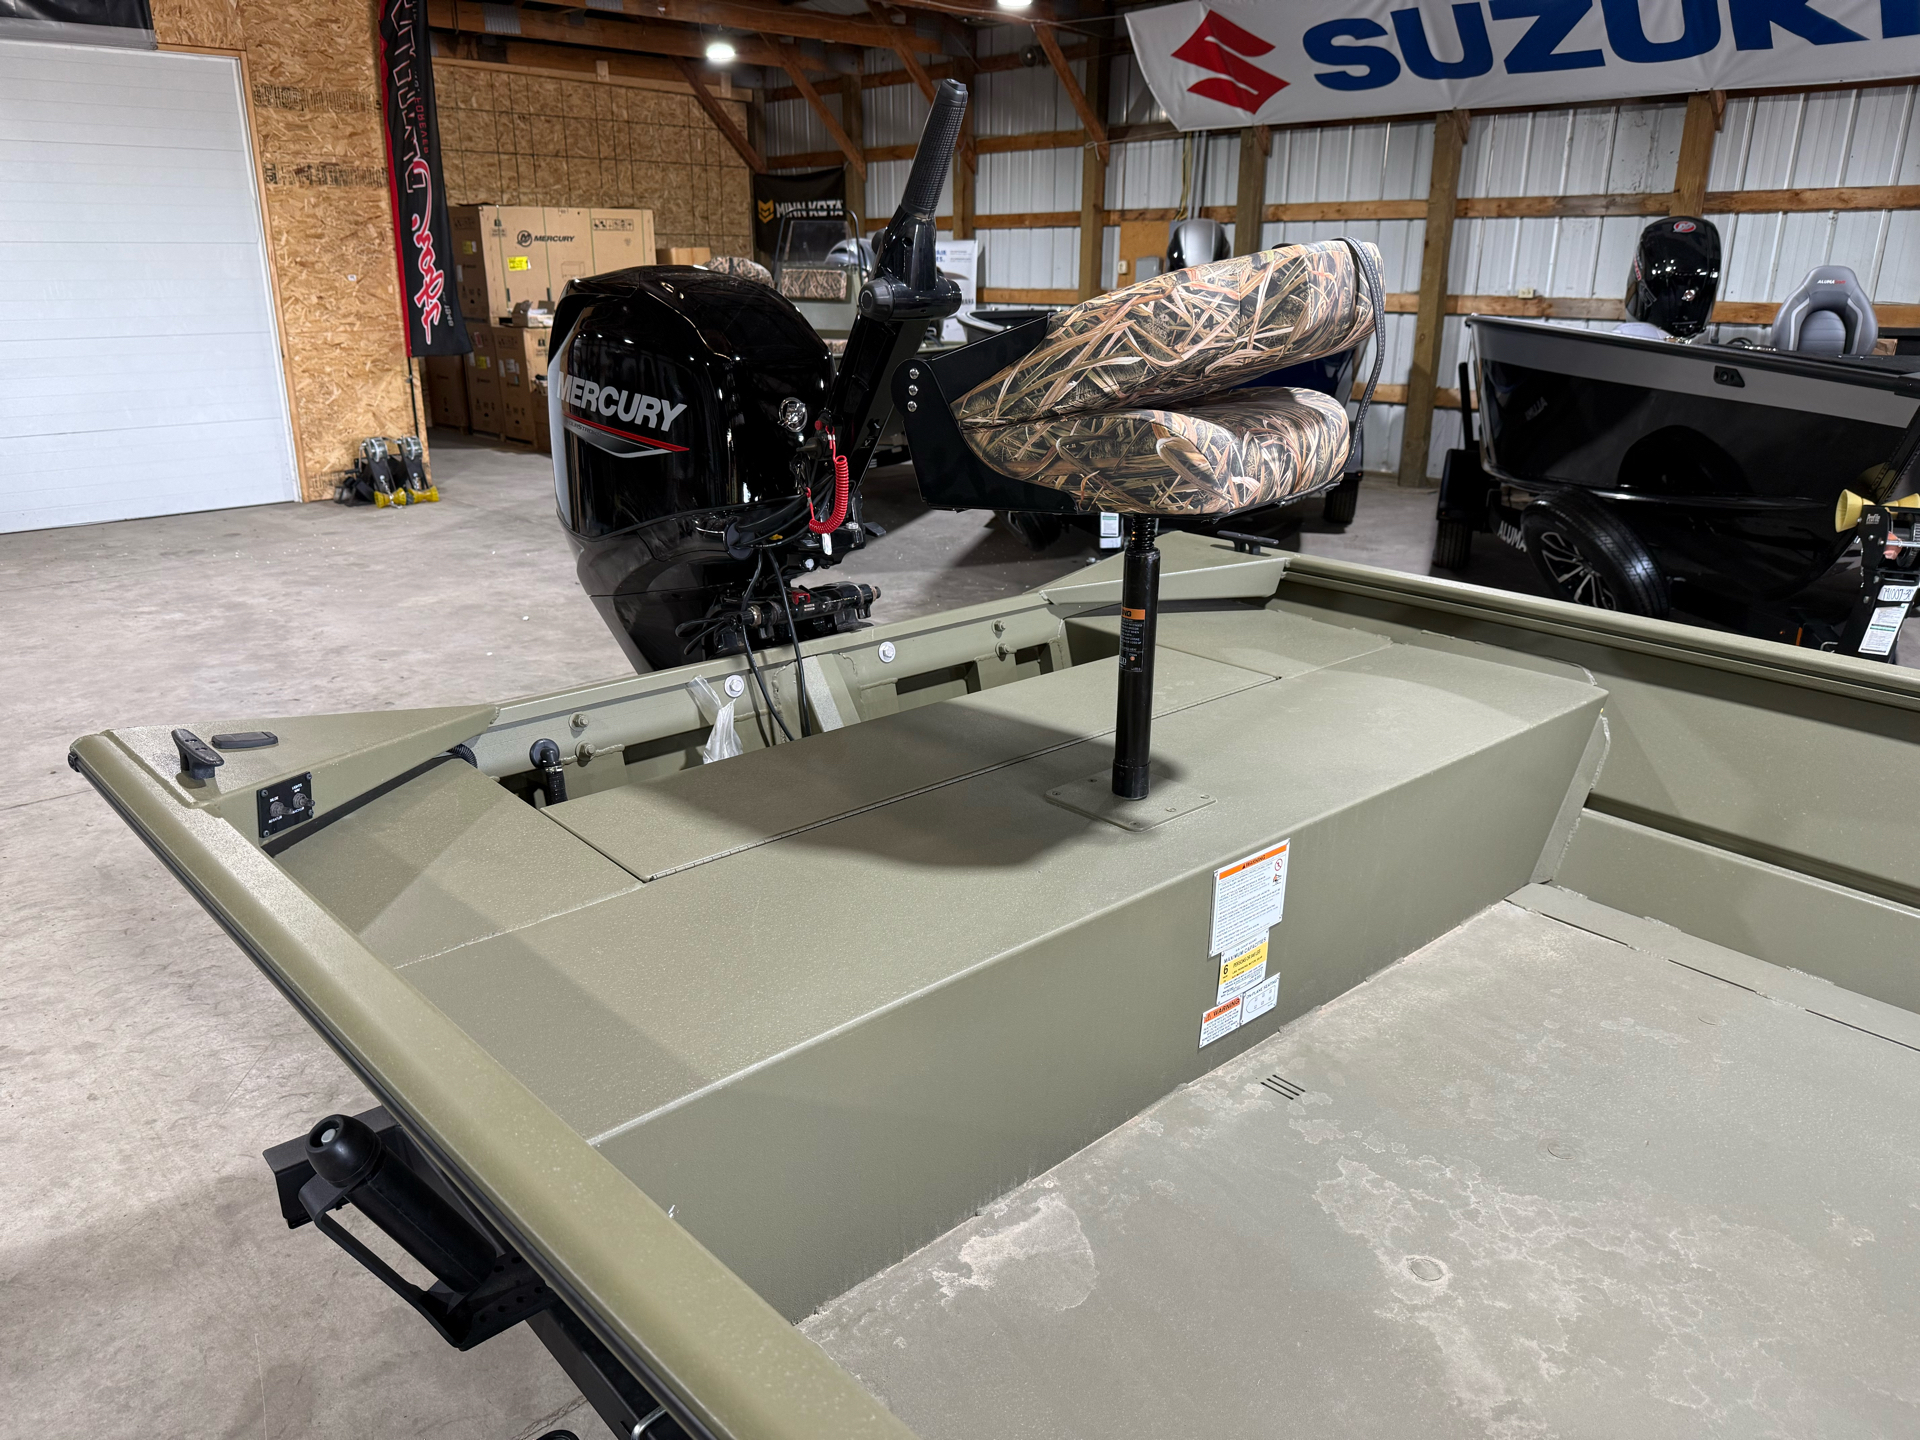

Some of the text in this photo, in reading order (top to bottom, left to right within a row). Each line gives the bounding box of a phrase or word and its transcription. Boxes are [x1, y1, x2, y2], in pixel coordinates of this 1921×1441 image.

[808, 199, 844, 217] KOTA
[533, 234, 575, 243] MERCURY
[556, 370, 688, 432] MERCURY
[1223, 949, 1244, 963] MAXIMUM
[1223, 964, 1229, 975] 6
[1213, 997, 1241, 1016] WARNING
